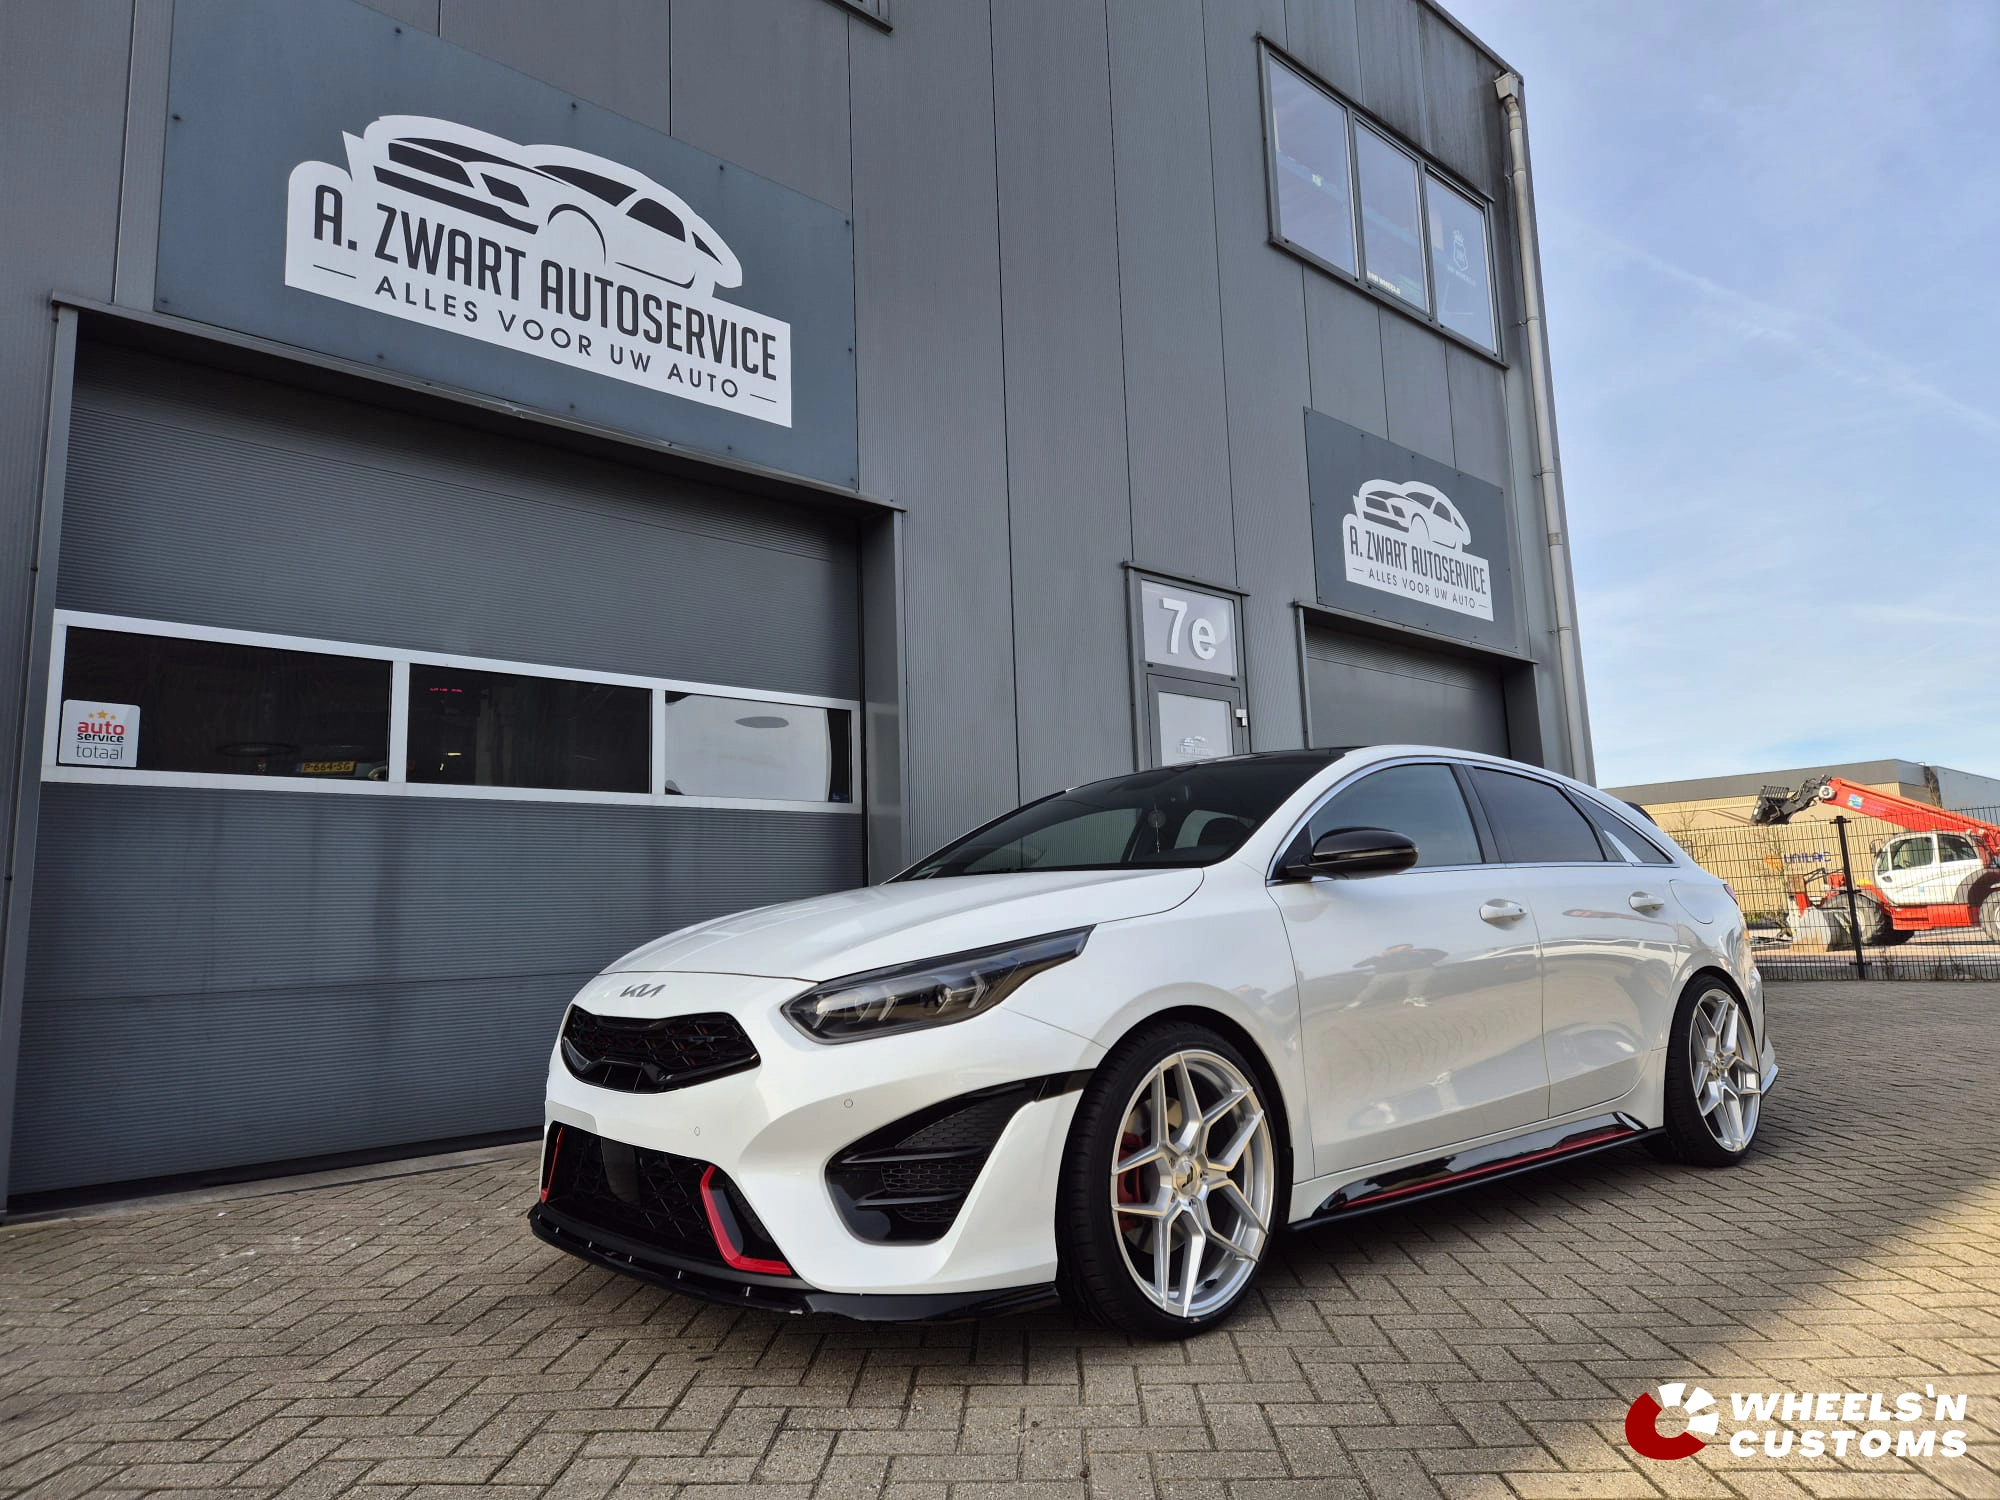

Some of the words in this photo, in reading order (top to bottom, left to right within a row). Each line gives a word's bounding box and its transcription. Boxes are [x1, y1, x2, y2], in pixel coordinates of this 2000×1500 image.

[313, 184, 358, 252] A.
[373, 202, 527, 301] ZWART
[540, 259, 778, 381] AUTOSERVICE
[374, 276, 479, 323] ALLES
[497, 309, 593, 357] VOOR
[610, 343, 653, 374] UW
[667, 363, 740, 398] AUTO
[1349, 525, 1364, 558] A.
[1365, 530, 1409, 571] ZWART
[1411, 545, 1488, 596] AUTOSERVICE
[1368, 568, 1399, 586] ALLES
[1401, 577, 1431, 596] VOOR
[1434, 587, 1449, 601] UW
[1452, 593, 1476, 609] AUTO
[1162, 597, 1217, 660] 7e
[76, 733, 124, 743] service
[76, 744, 123, 760] totaal
[77, 720, 125, 736] auto
